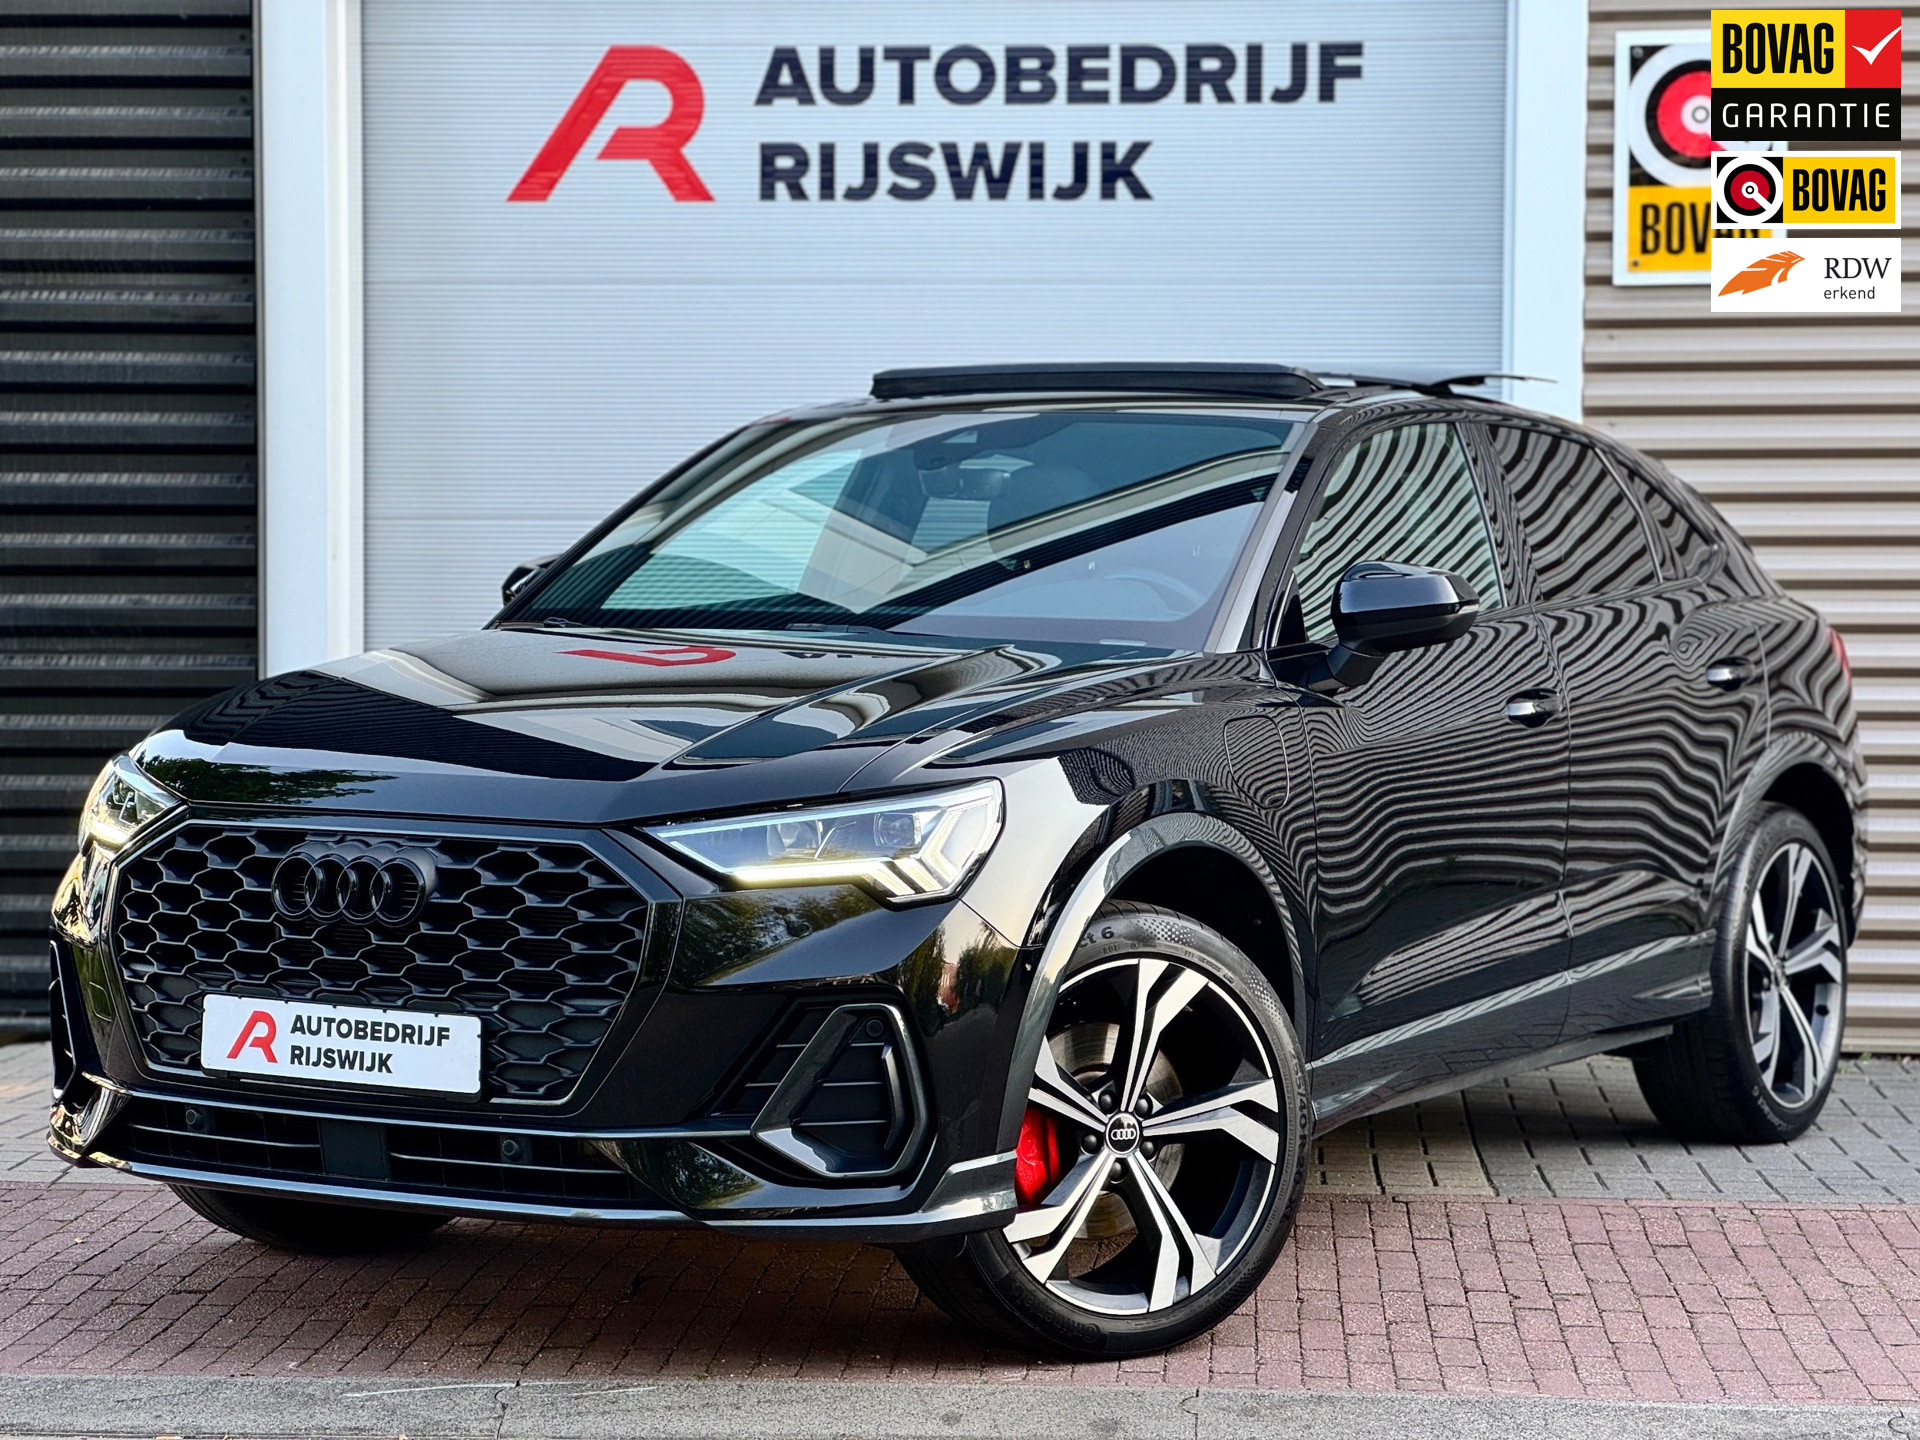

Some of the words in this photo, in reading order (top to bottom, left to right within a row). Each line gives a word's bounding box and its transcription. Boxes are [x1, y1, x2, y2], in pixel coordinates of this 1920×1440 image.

[755, 41, 1363, 106] AUTOBEDRIJF
[758, 140, 1154, 201] RIJSWIJK
[1640, 202, 1761, 255] BOV
[290, 1014, 451, 1047] AUTOBEDRIJF
[290, 1045, 393, 1074] RIJSWIJK
